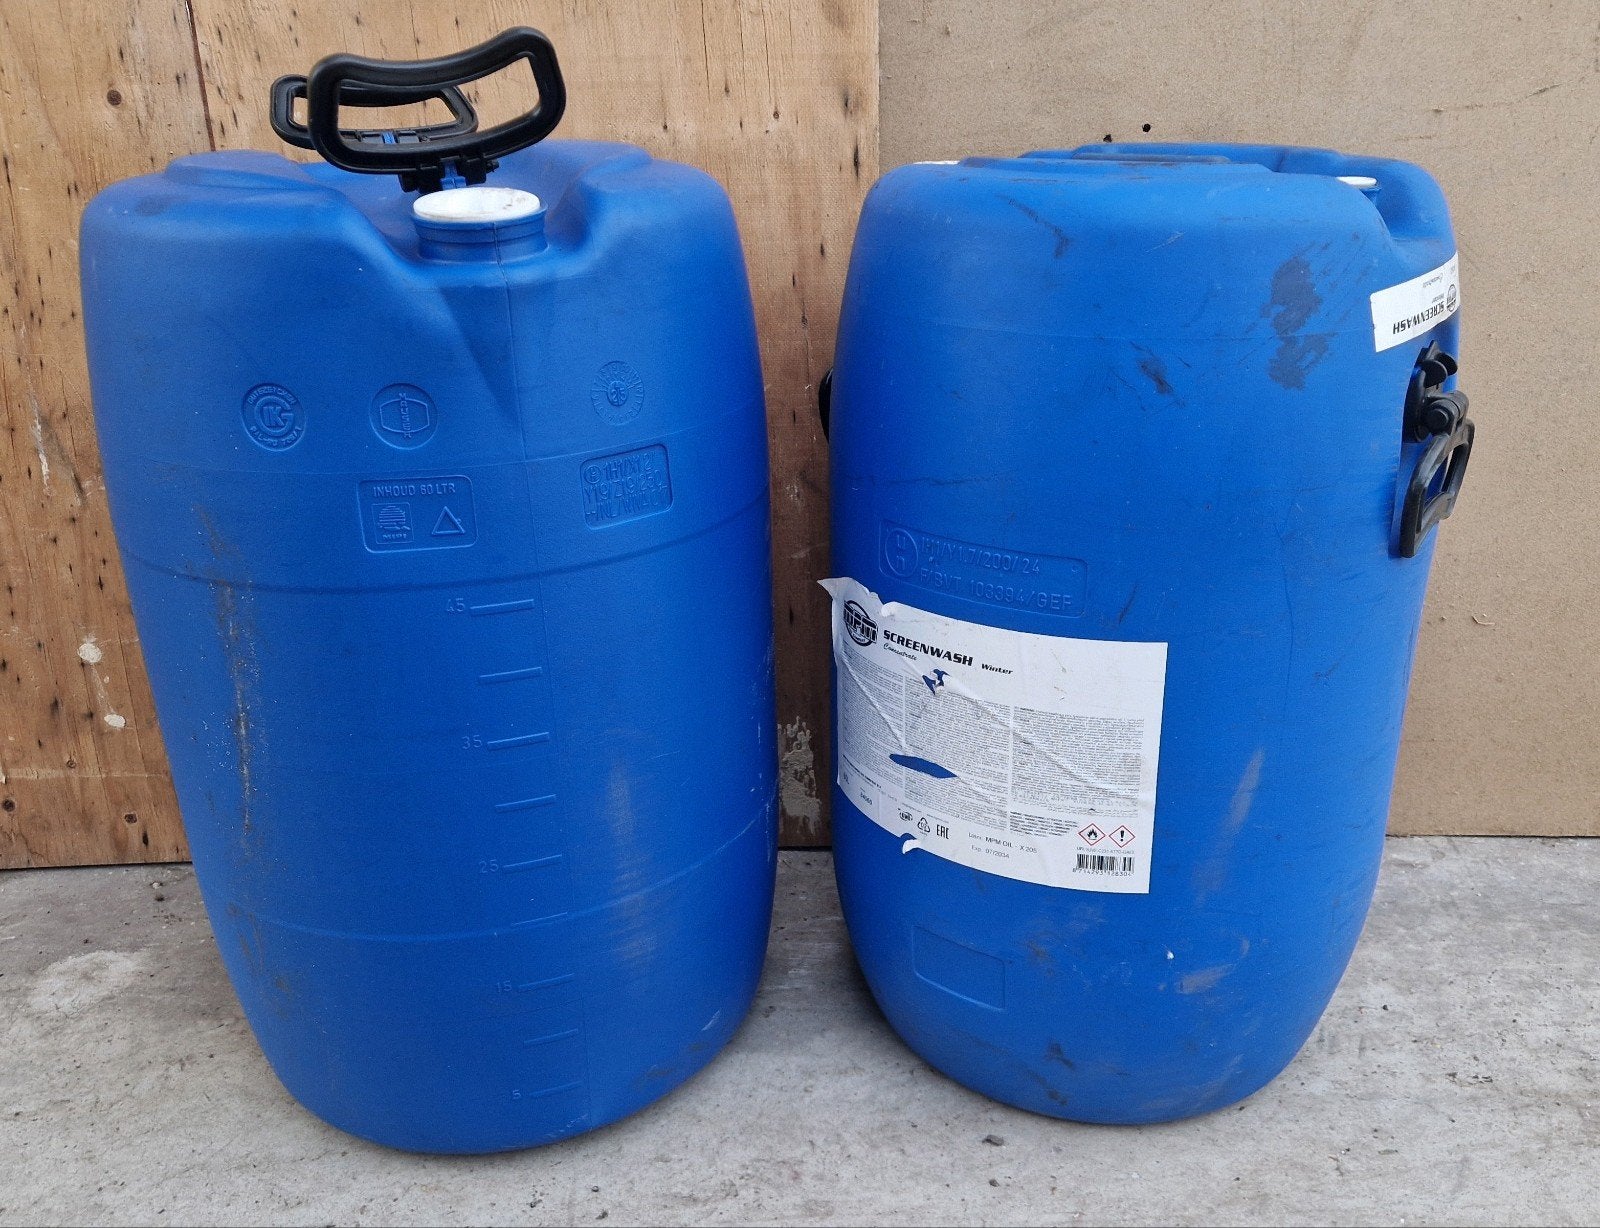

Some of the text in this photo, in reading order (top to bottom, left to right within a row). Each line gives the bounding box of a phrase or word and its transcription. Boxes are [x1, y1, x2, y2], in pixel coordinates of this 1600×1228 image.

[1392, 301, 1445, 335] SCREENWASH
[373, 483, 456, 498] INHOUD 60 LTR
[446, 598, 466, 613] 45
[883, 629, 973, 667] SCREENWASH
[981, 663, 1014, 675] Winter
[883, 643, 918, 661] Concentrate
[461, 735, 483, 750] 35
[478, 859, 499, 874] 25
[512, 1089, 522, 1100] 5
